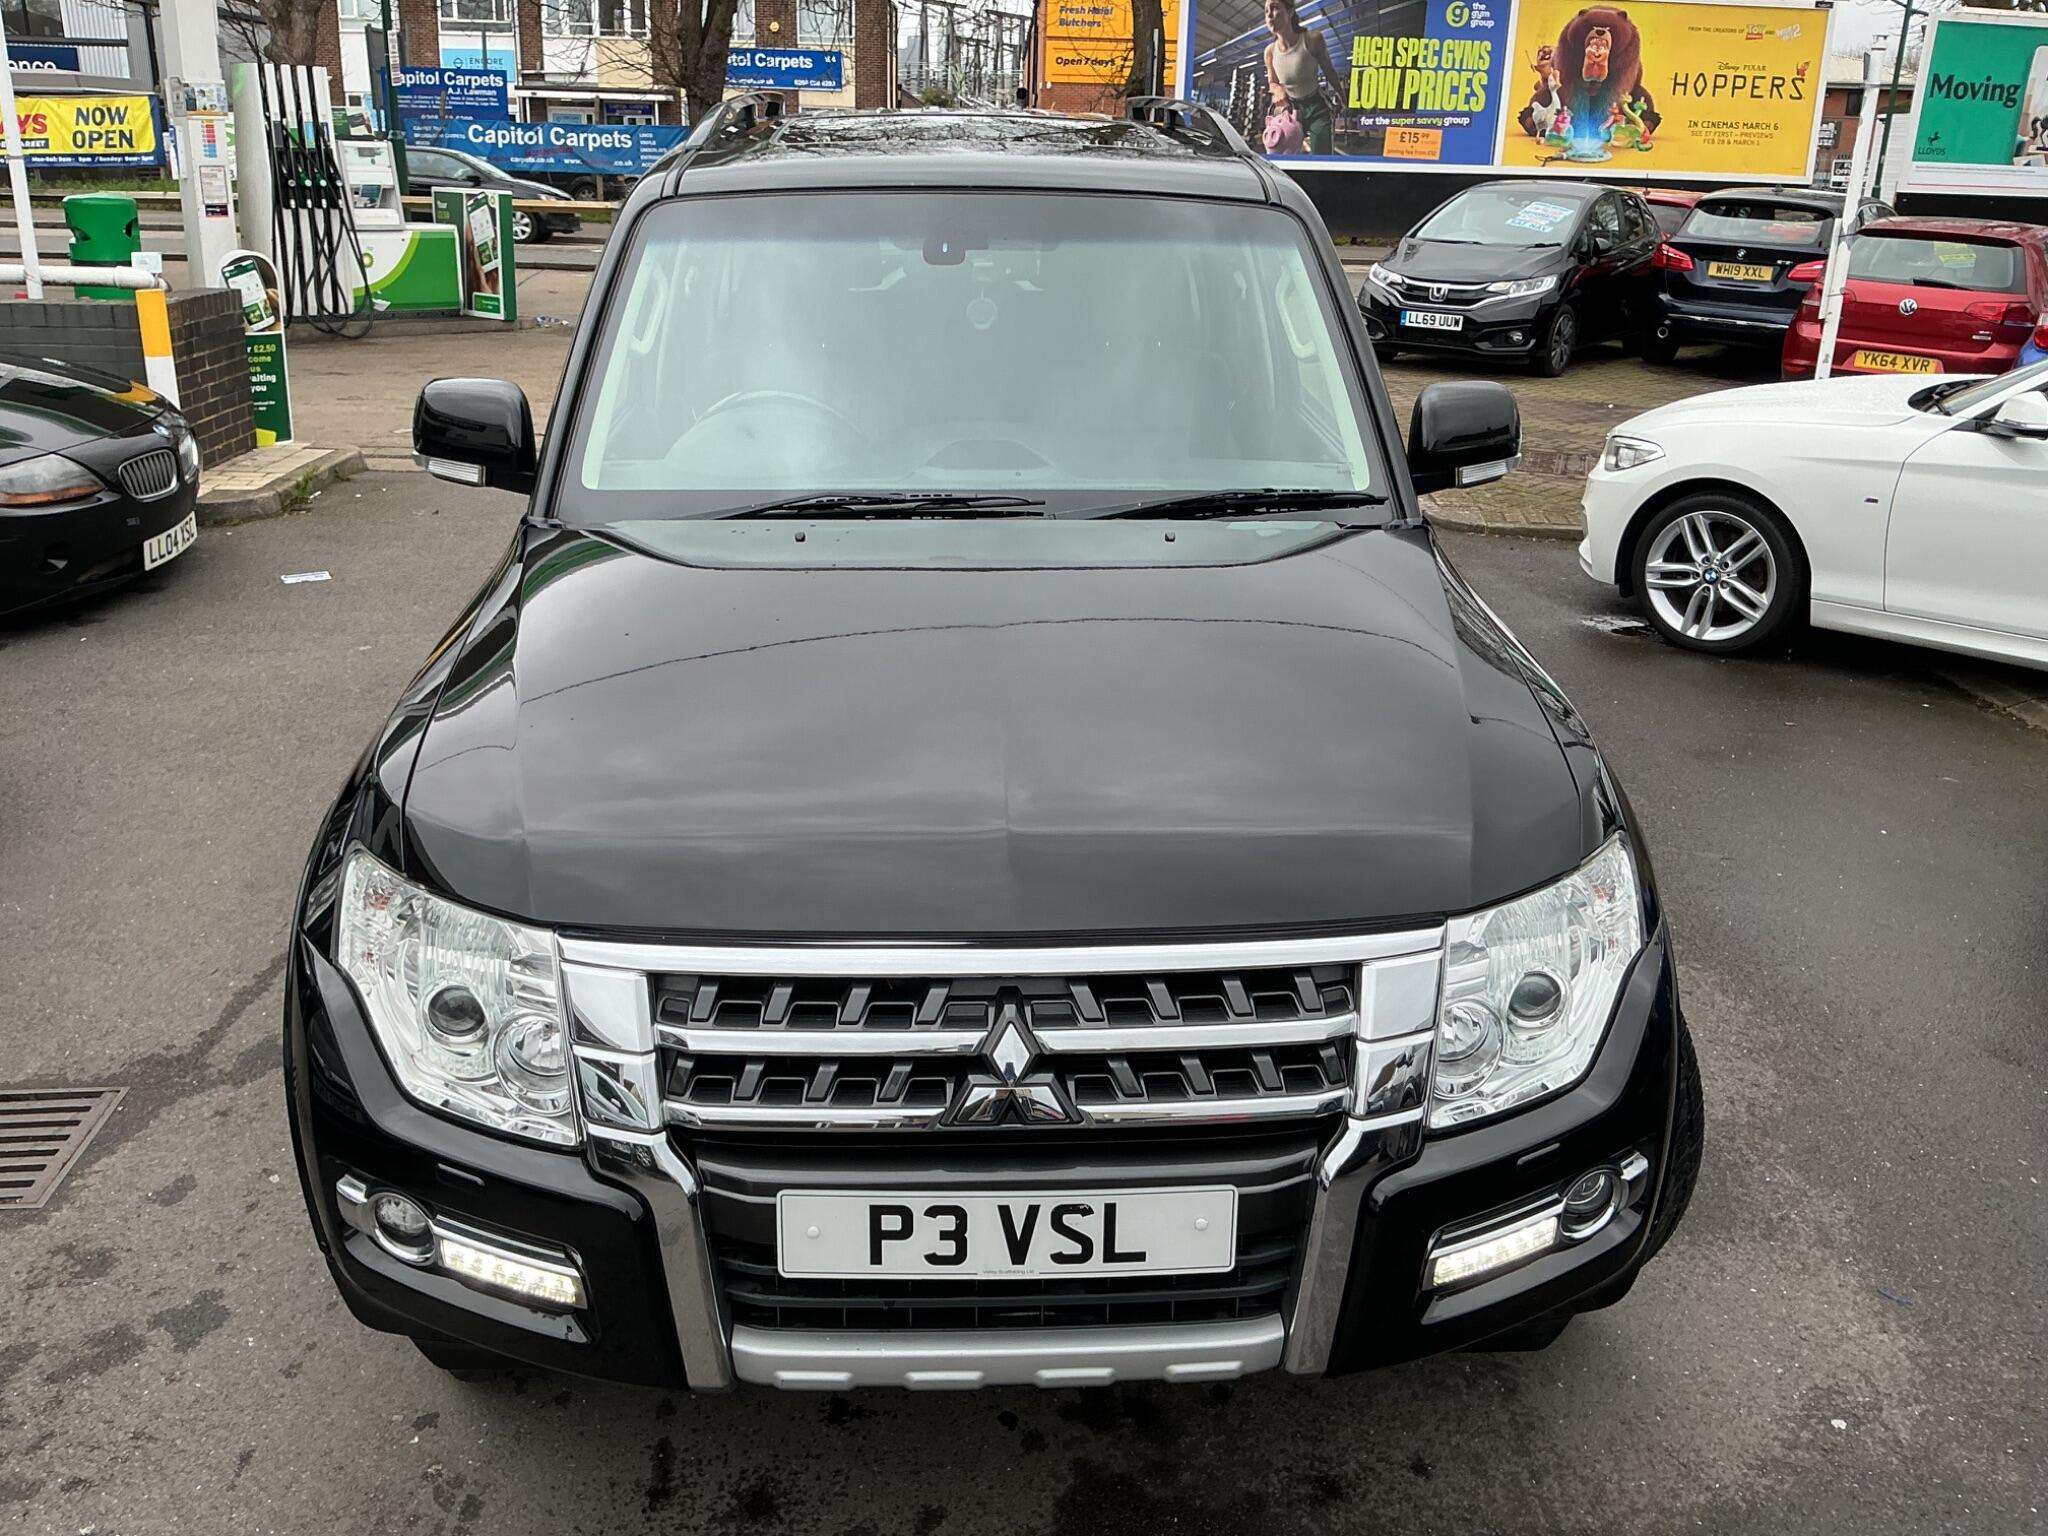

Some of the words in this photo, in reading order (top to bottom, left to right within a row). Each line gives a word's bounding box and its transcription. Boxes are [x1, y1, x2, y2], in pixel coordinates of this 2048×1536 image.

[1059, 5, 1085, 15] Fresh
[1472, 2, 1486, 10] the
[1471, 10, 1490, 19] gym
[1059, 18, 1101, 27] Butchers
[1470, 19, 1495, 29] group
[1352, 36, 1394, 66] HIGH
[1395, 37, 1440, 69] SPEC
[1441, 39, 1492, 71] GYMS
[755, 53, 813, 71] Carpets
[1056, 56, 1082, 66] Open
[1091, 57, 1116, 68] days
[1716, 61, 1739, 72] Disney
[1743, 64, 1766, 72] PIXAR
[444, 72, 504, 88] Carpets
[1672, 72, 1806, 101] HOPPERS
[1348, 67, 1402, 110] LOW
[1402, 69, 1488, 113] PRICES
[1929, 73, 2021, 108] Moving
[75, 105, 129, 127] NOW
[1360, 117, 1373, 125] for
[1375, 117, 1390, 125] the
[1391, 118, 1415, 126] super
[1416, 118, 1443, 126] savvy
[1443, 117, 1470, 127] group
[1688, 120, 1698, 128] IN
[1701, 120, 1740, 129] CINEMAS
[1742, 121, 1771, 130] MARCH
[1773, 122, 1779, 130] 6
[72, 130, 135, 149] OPEN
[468, 124, 543, 148] Capitol
[550, 127, 633, 152] Carpets
[1399, 131, 1419, 144] £15
[1917, 147, 1946, 156] LLOYDS
[1716, 263, 1741, 276] WH19
[1743, 266, 1764, 278] XXL
[1408, 313, 1436, 325] LL69
[1438, 315, 1461, 328] UUW
[254, 344, 276, 353] £2.50
[1863, 352, 1898, 367] YK64
[1900, 357, 1930, 372] XVR
[250, 373, 276, 383] aiting
[250, 385, 267, 393] you
[149, 529, 179, 564] LL04
[869, 1202, 969, 1267] P3
[997, 1202, 1147, 1267] VSL
